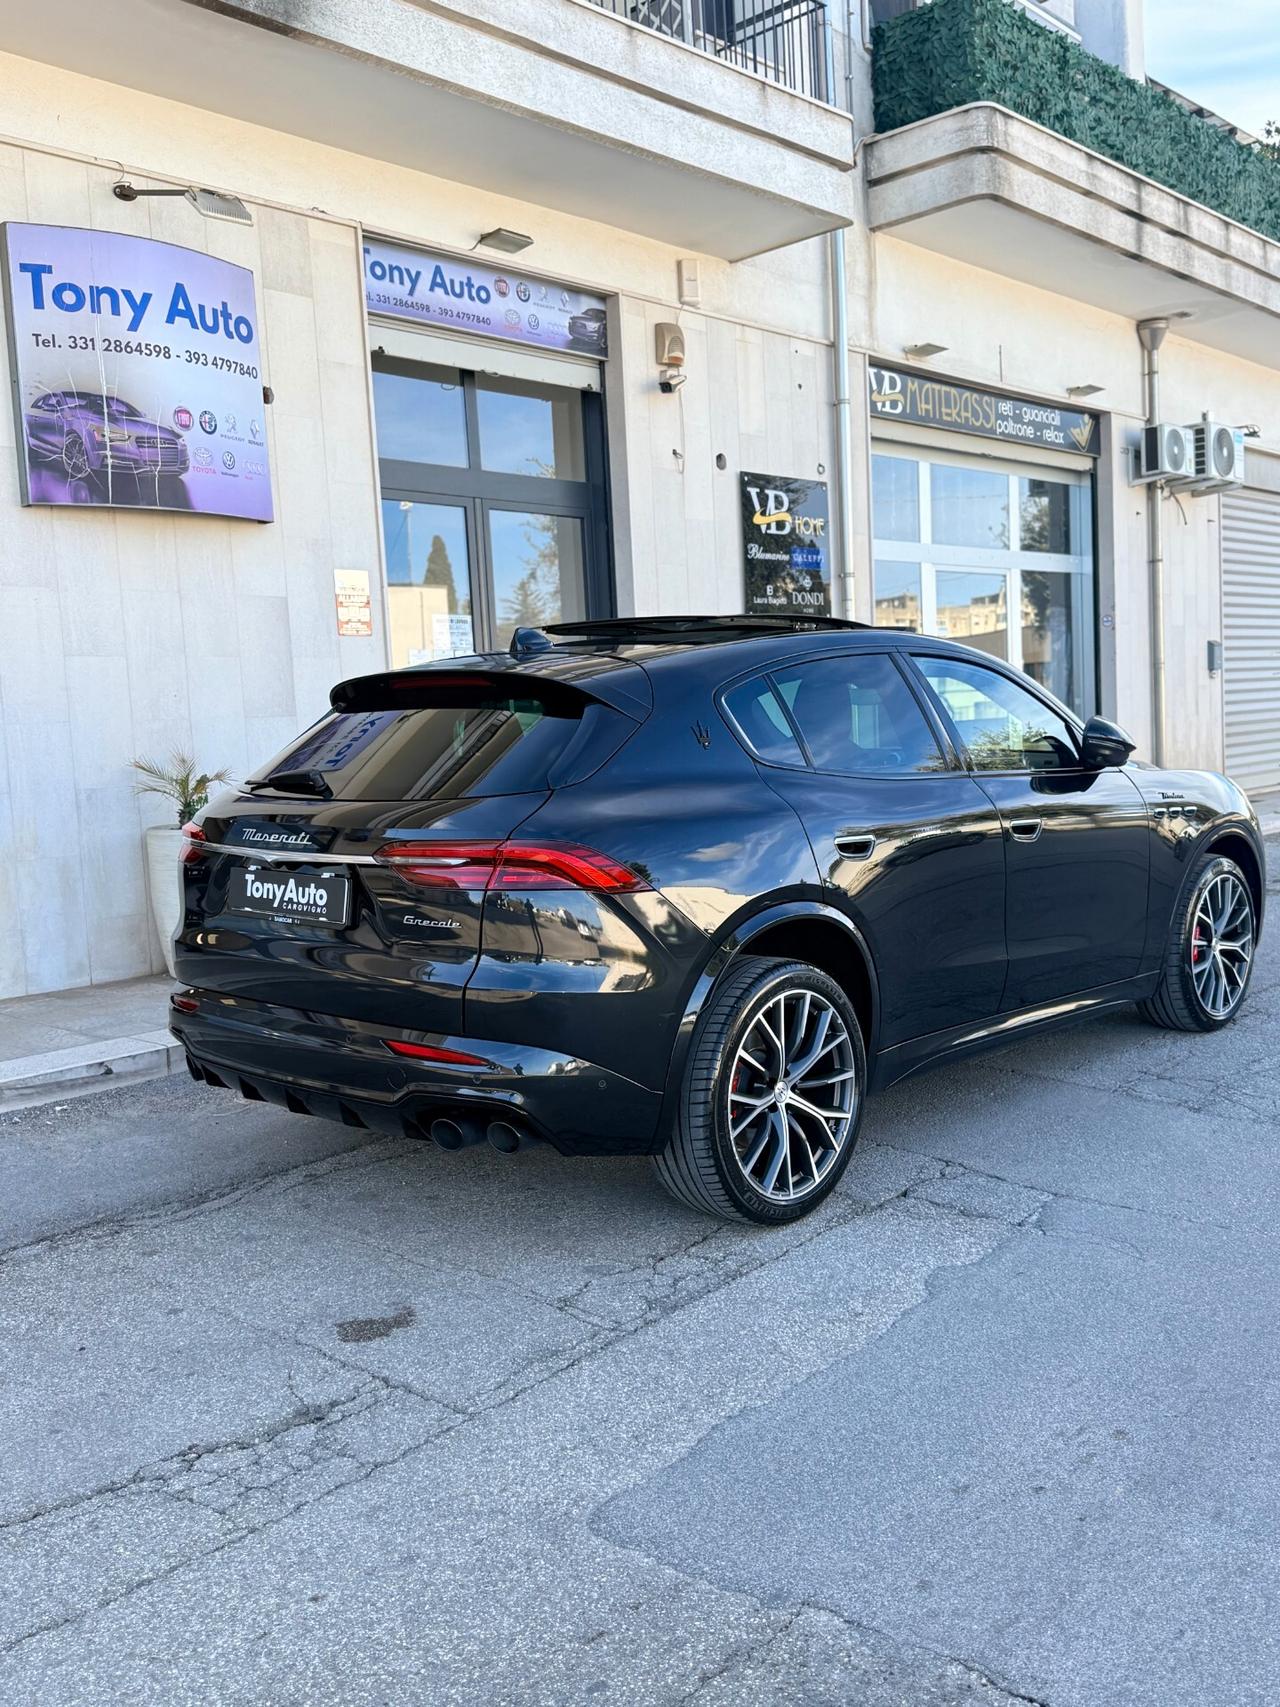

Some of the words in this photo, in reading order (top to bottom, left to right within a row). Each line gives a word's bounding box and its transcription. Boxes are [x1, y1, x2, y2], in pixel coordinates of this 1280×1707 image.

[429, 264, 491, 304] Auto
[19, 262, 153, 332] Tony
[165, 282, 254, 344] Auto
[376, 293, 391, 304] 331
[393, 297, 431, 313] 2864598
[438, 306, 453, 318] 393
[455, 310, 491, 326] 4797840
[32, 333, 62, 349] Tel.
[68, 335, 95, 351] 331
[102, 338, 171, 359] 2864598
[185, 350, 208, 367] 393
[211, 357, 258, 380] 4797840
[906, 379, 996, 430] MATERASSI
[998, 401, 1013, 416] reti
[1022, 406, 1061, 426] guanciali
[996, 419, 1034, 438] poltrone
[1043, 429, 1064, 444] relax
[191, 465, 217, 474] TOYOTA
[747, 487, 792, 535] VB
[795, 516, 824, 536] HOME
[747, 543, 790, 561] Blumarine
[792, 591, 824, 606] DONDI
[242, 828, 312, 845] Maserati
[245, 873, 327, 908] TonyAuto
[282, 903, 327, 914] CAROVIGNO
[403, 915, 462, 929] Grecale
